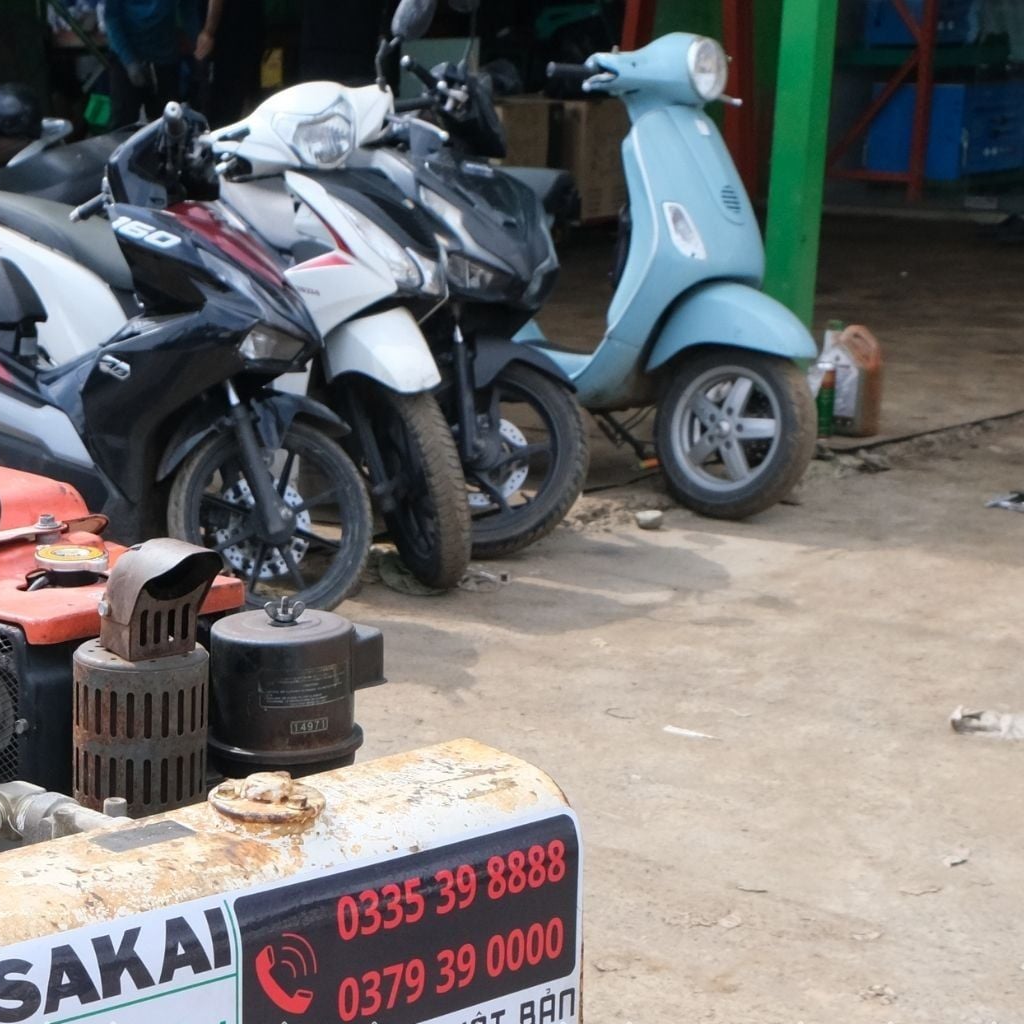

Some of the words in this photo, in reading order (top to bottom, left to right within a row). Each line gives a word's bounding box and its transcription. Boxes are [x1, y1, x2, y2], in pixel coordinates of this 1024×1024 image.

[112, 216, 182, 248] 160
[293, 718, 327, 732] 14971
[337, 877, 424, 940] 0335
[435, 864, 477, 915] 39
[487, 839, 565, 900] 8888
[338, 958, 425, 1022] 0379
[435, 943, 476, 994] 39
[486, 917, 564, 978] 0000
